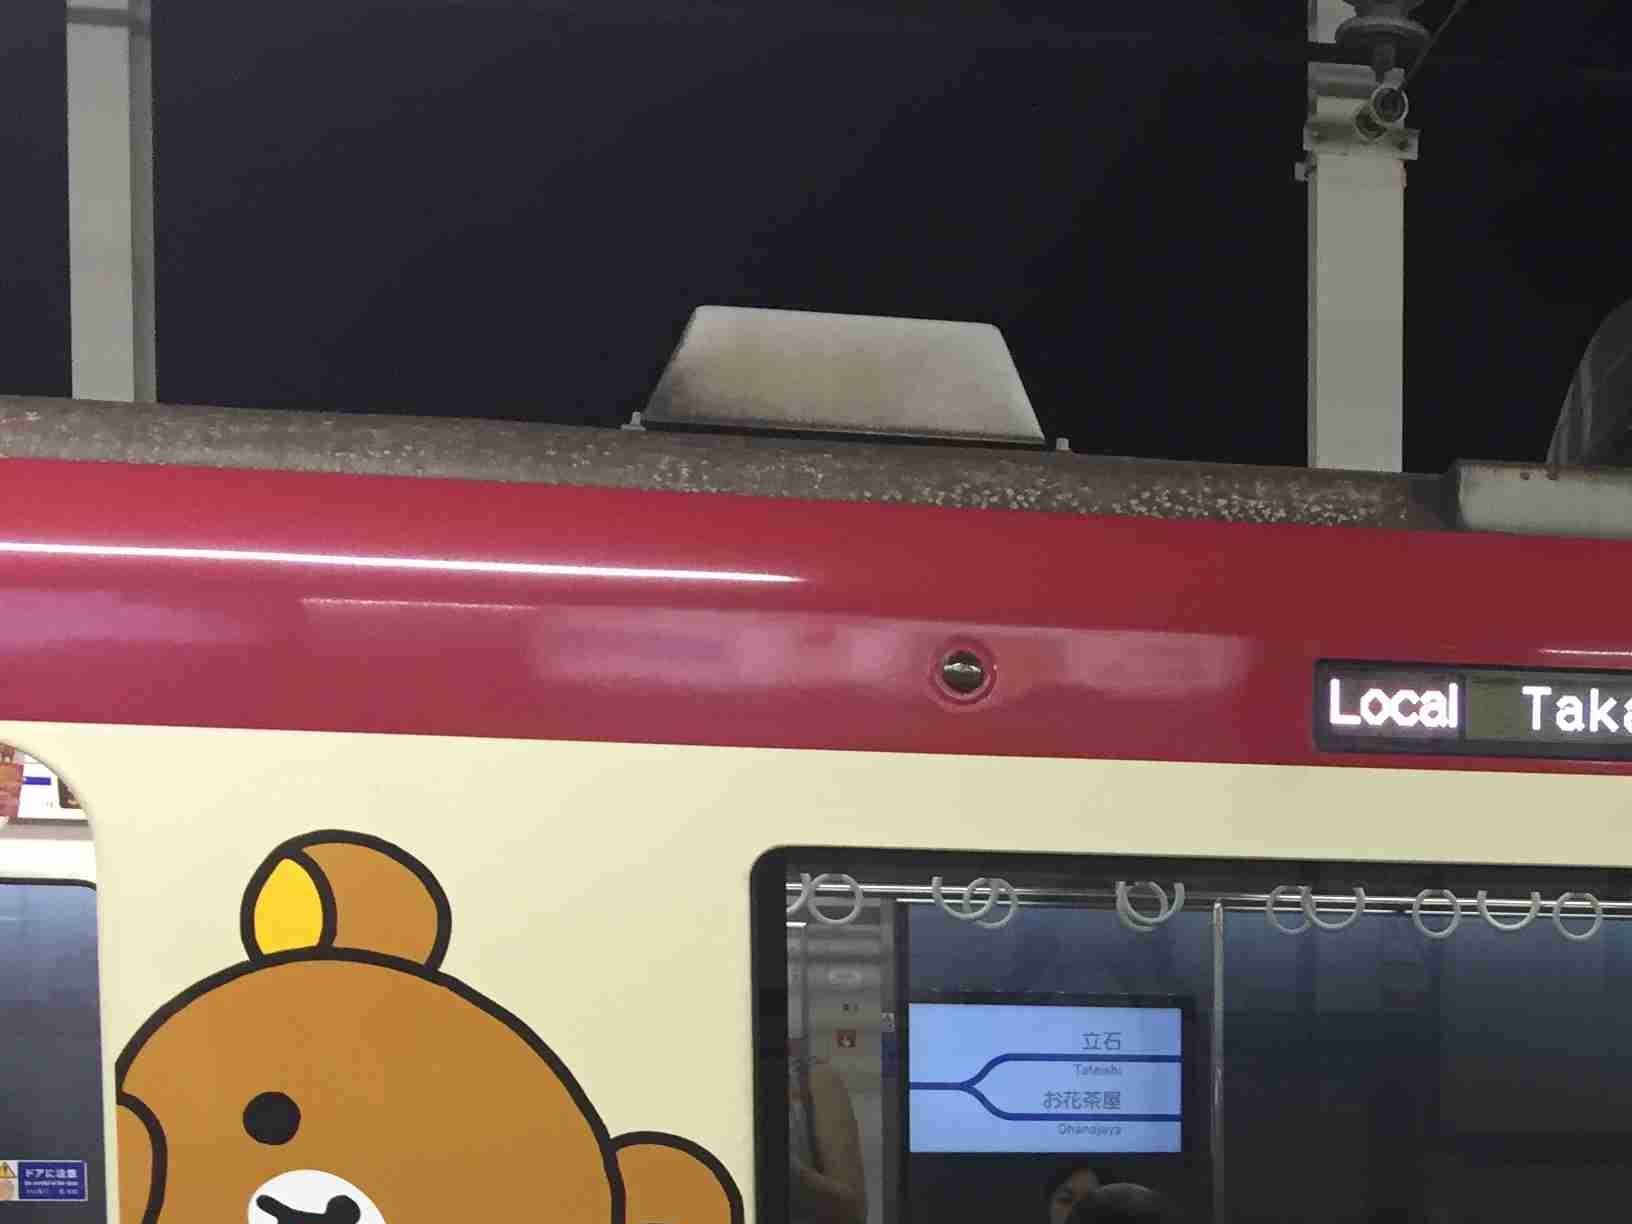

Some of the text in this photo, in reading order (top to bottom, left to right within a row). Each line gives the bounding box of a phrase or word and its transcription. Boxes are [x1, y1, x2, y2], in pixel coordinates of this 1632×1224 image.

[1329, 677, 1459, 729] Local
[1081, 1031, 1121, 1050] 立石
[1042, 1090, 1121, 1111] お花茶屋
